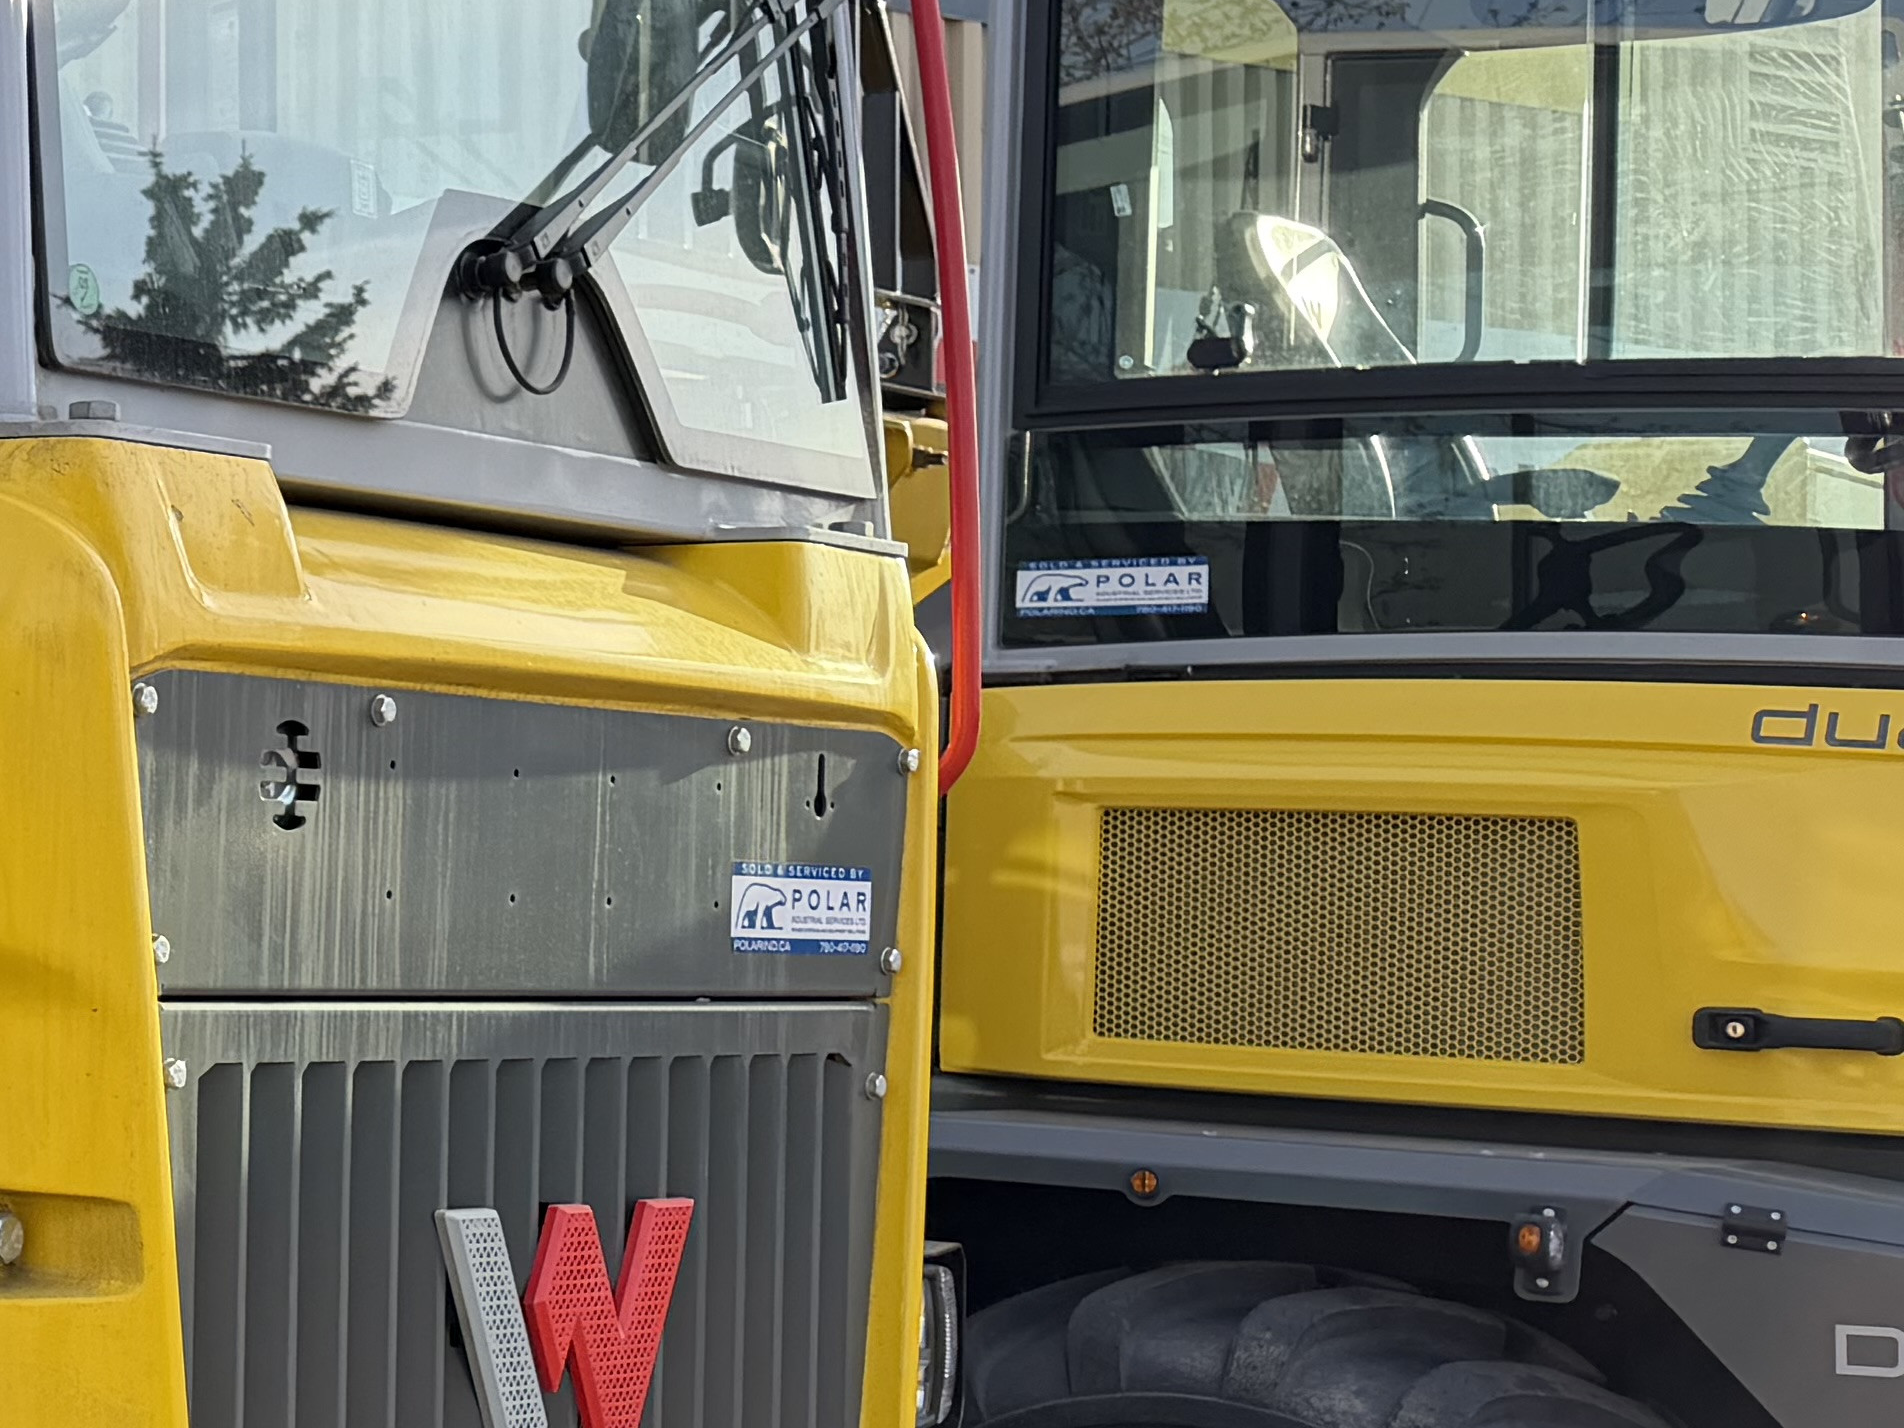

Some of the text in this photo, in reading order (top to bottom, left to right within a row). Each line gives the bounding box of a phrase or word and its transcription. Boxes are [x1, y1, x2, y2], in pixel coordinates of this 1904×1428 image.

[1096, 572, 1203, 588] POLAR
[1749, 703, 1904, 749] du
[791, 888, 867, 912] POLAR
